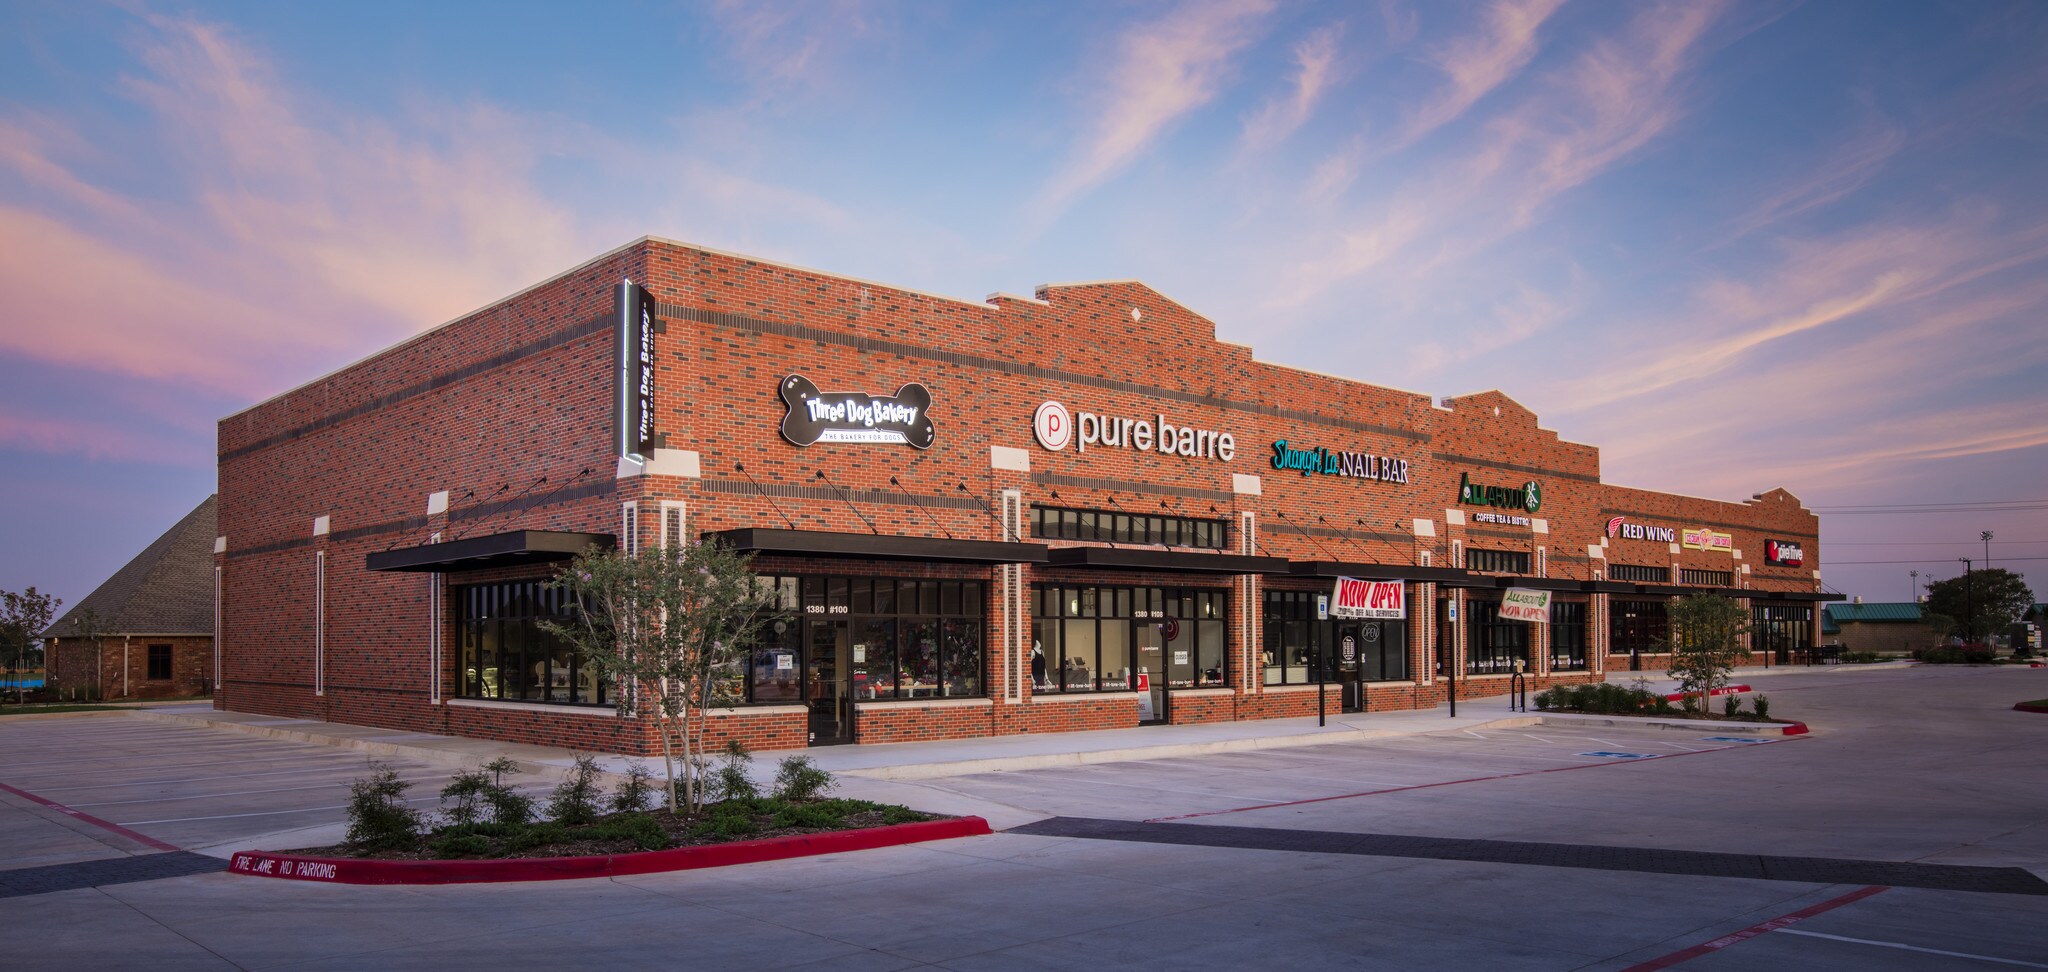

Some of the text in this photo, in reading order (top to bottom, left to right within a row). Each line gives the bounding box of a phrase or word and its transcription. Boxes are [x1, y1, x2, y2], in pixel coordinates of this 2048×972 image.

[640, 310, 651, 443] Three Dog Bakery
[807, 398, 916, 427] Three Dog Bakery
[1048, 414, 1060, 437] p
[1077, 411, 1235, 462] pure barre
[1274, 439, 1408, 483] Shangri La NAIL BAR
[1475, 513, 1529, 526] COFFEE TEA & BISTRO
[1622, 523, 1644, 539] RED
[1645, 525, 1674, 542] WING
[1338, 579, 1401, 609] NOW OPEN
[806, 605, 848, 614] 1380 #100
[1337, 607, 1399, 617] 20% OFF ALL SERVICES
[1500, 604, 1547, 621] NOW OPEN
[235, 855, 336, 878] FIRE LANE NO PARKING
